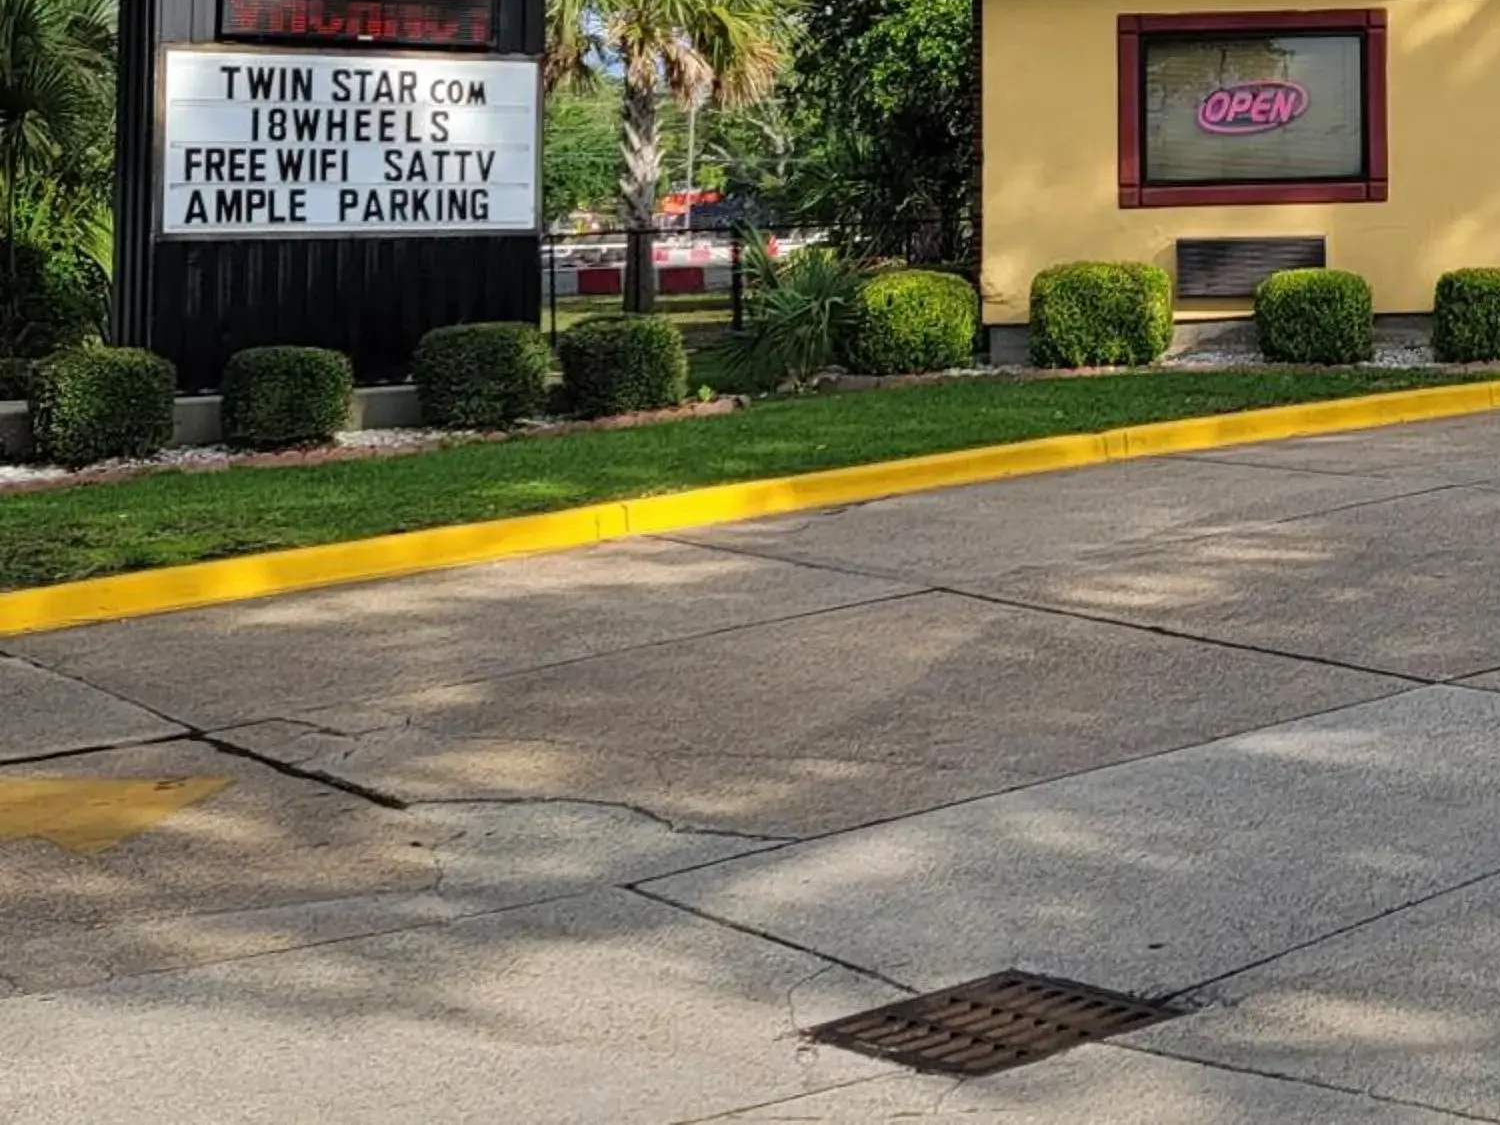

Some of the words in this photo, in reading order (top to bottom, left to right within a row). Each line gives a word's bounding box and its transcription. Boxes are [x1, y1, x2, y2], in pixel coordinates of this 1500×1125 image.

[221, 66, 312, 101] TWIN
[332, 69, 416, 103] STAR
[430, 79, 487, 105] COM
[1205, 89, 1297, 123] OPEN
[184, 148, 266, 182] FREE
[276, 148, 348, 182] WIFI
[184, 189, 307, 223] AMPLE
[339, 189, 489, 222] PARKING
